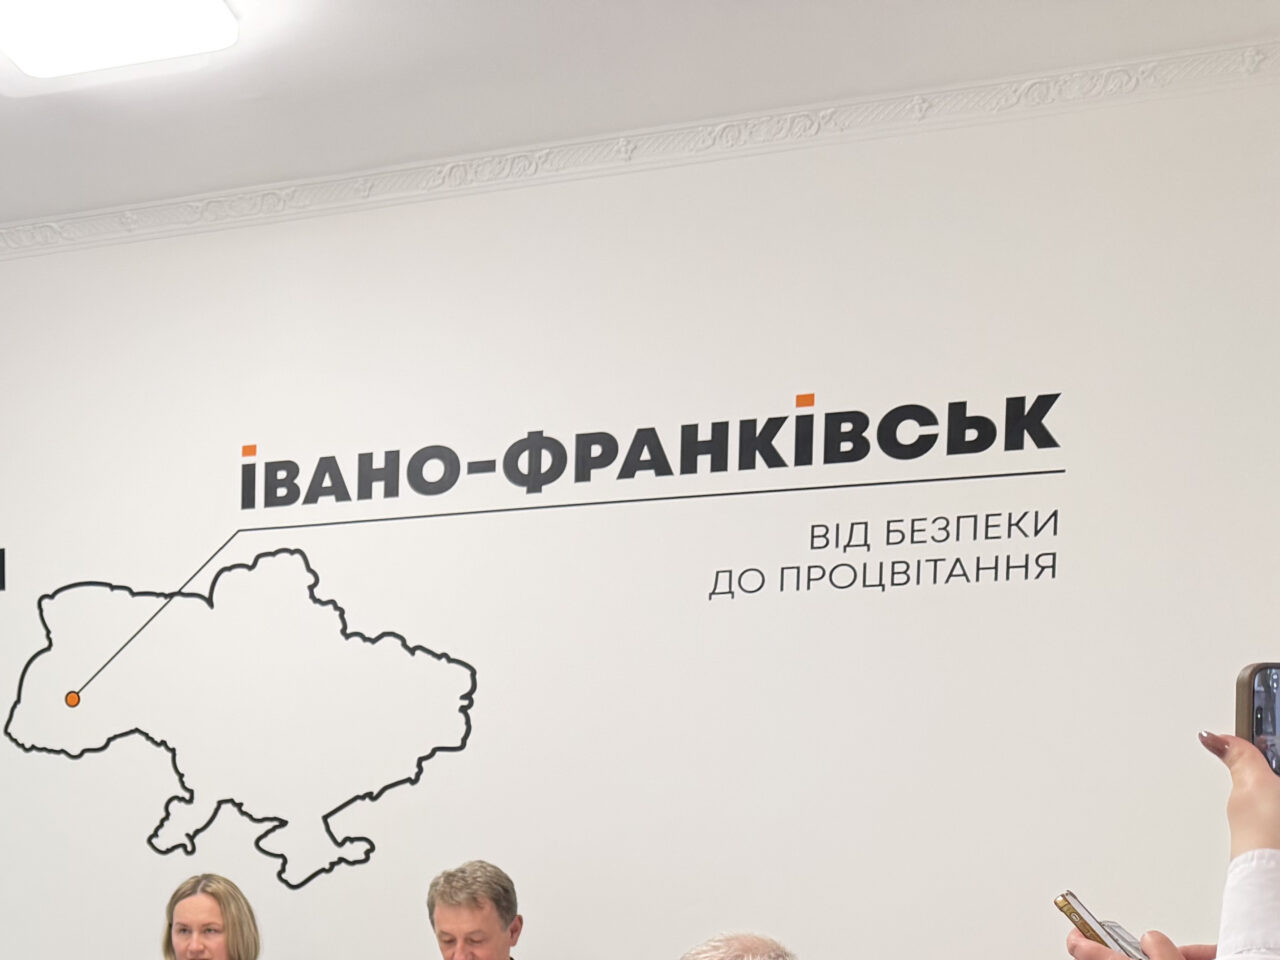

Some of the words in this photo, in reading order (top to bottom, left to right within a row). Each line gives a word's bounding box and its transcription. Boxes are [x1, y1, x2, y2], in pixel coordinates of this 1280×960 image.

[241, 393, 1061, 510] ІВАНО-ФРАНКІВСЬК
[810, 521, 870, 553] ВІД
[886, 510, 1059, 546] БЕЗПЕКИ
[709, 568, 765, 600] ДО
[780, 552, 1058, 591] ПРОЦВІТАННЯ
